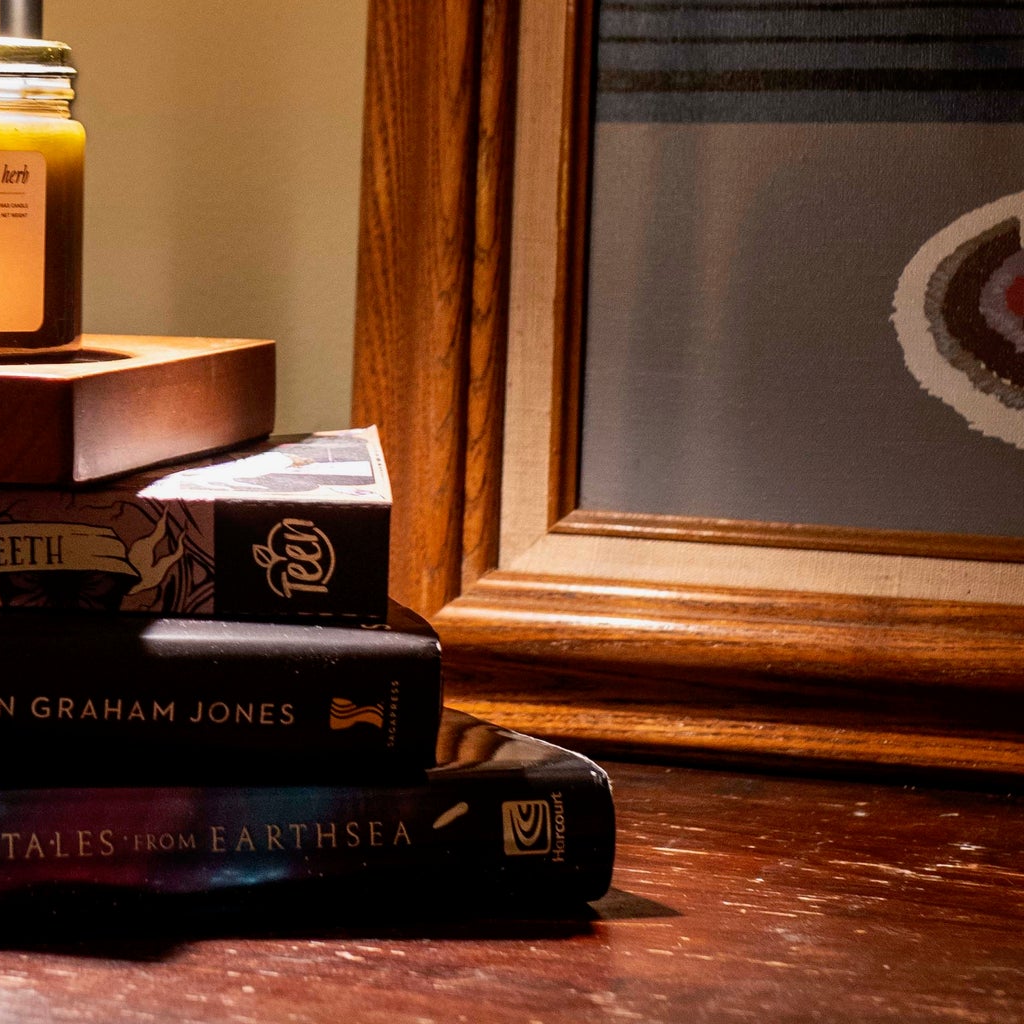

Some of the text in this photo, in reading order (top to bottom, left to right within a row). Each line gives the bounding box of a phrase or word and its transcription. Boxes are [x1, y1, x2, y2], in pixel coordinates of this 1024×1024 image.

[1, 163, 30, 184] herb
[30, 695, 176, 722] GRAHAM
[189, 700, 296, 726] JONES
[1, 820, 412, 860] TALES FROM EARTHSEA
[550, 791, 565, 862] Harcourt
